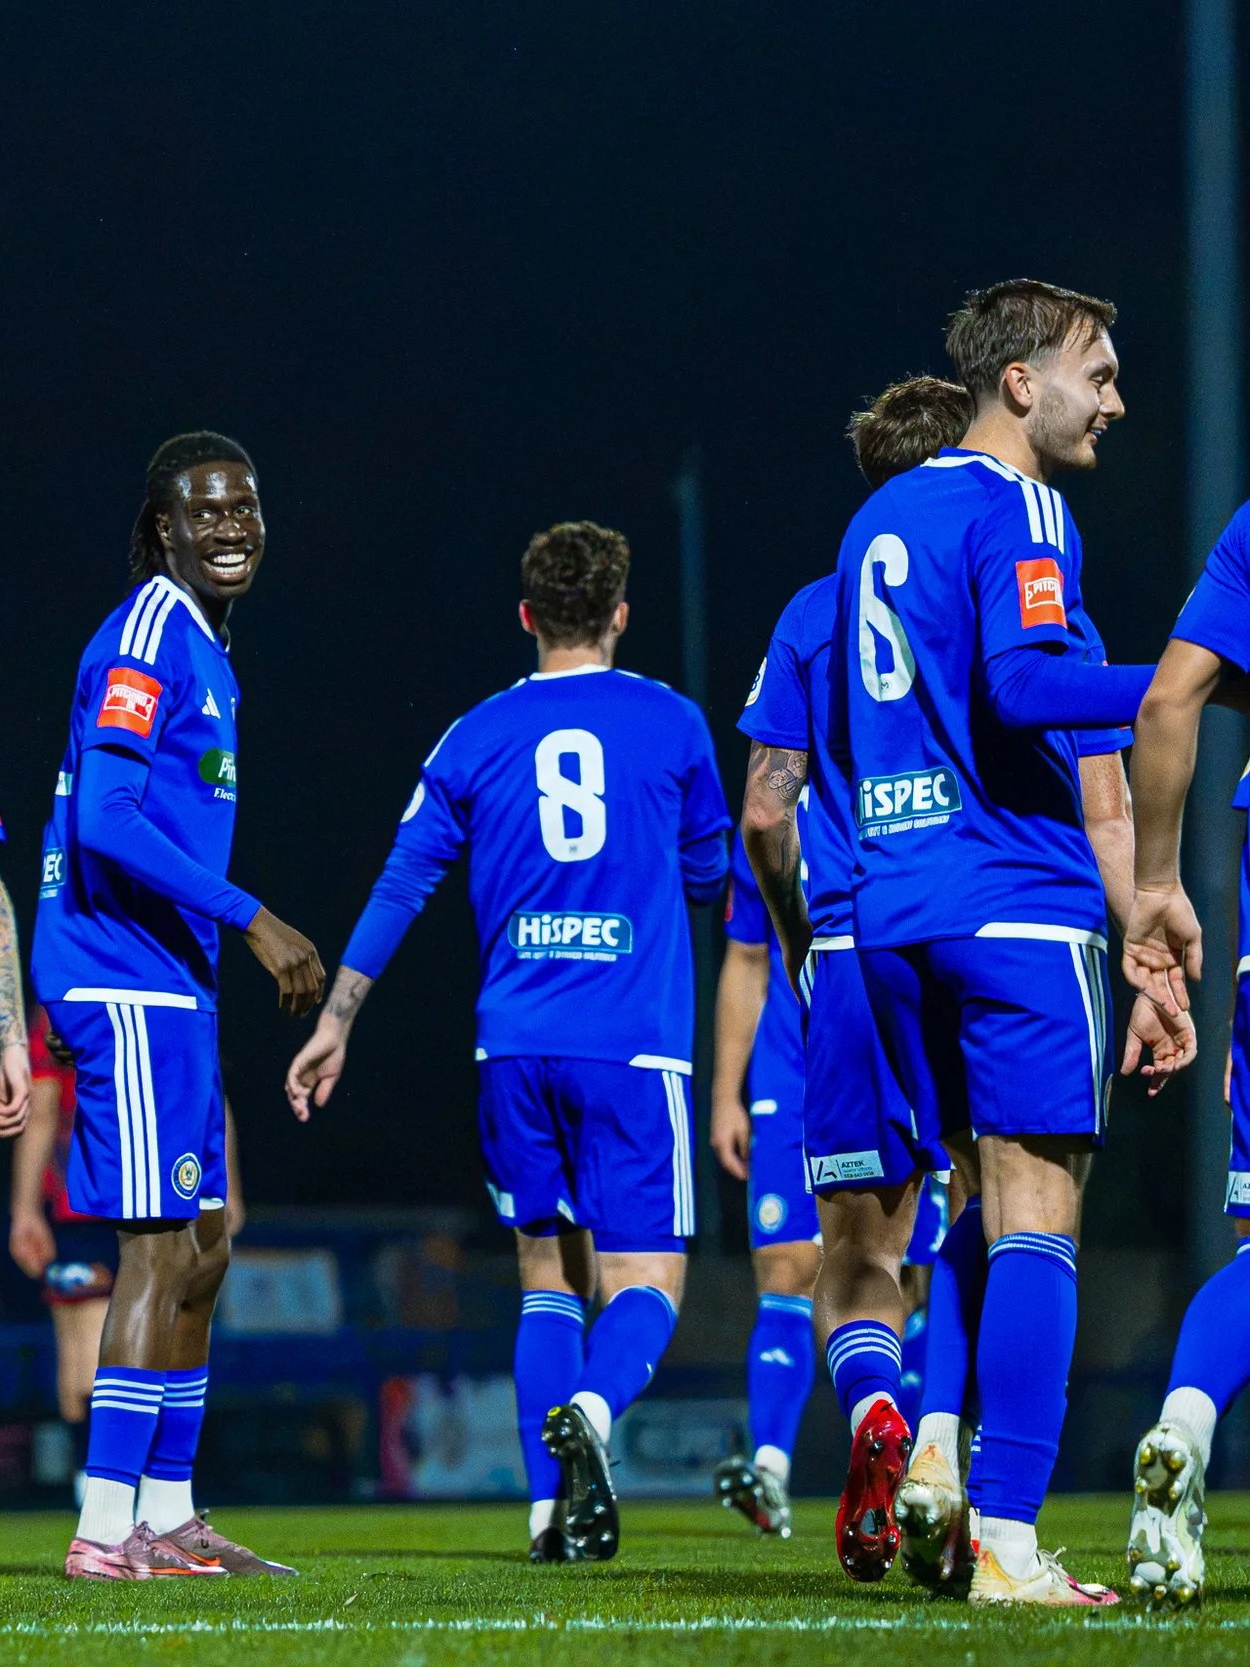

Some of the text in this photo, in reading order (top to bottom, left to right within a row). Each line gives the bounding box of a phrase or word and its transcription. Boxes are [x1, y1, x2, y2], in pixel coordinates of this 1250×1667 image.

[859, 533, 915, 702] 6
[535, 728, 606, 862] 8
[860, 774, 949, 822] iSPEC
[518, 914, 620, 947] HiSPEC
[841, 1160, 864, 1168] AZTEK
